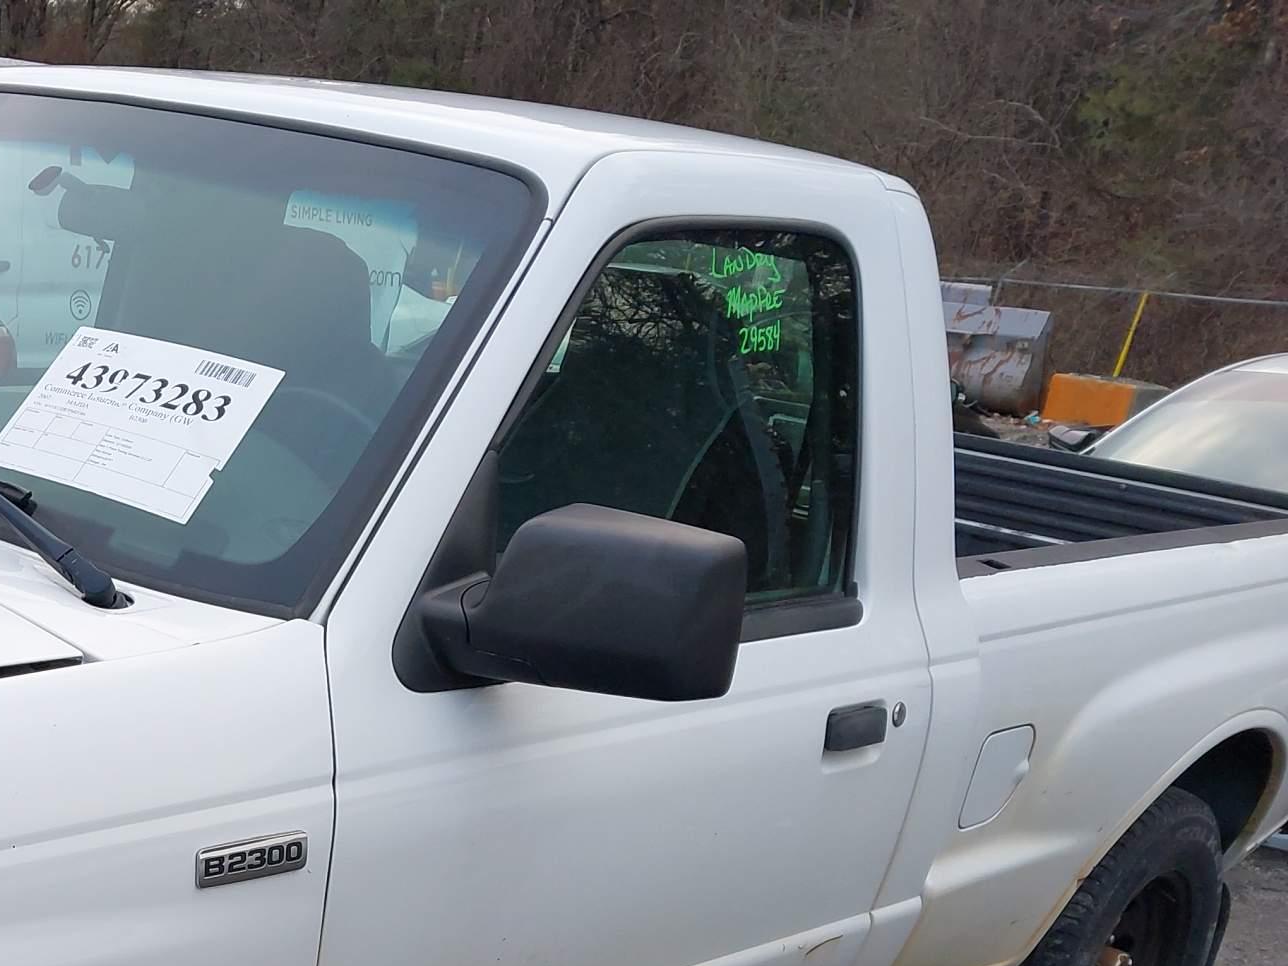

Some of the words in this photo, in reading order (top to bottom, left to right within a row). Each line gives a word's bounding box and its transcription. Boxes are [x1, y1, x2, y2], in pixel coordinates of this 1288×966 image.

[290, 204, 333, 222] SIMPLE
[335, 210, 373, 227] LIVING
[739, 319, 781, 354] 29584
[44, 383, 88, 399] Commerce
[88, 392, 128, 408] Insuranc
[128, 403, 169, 421] Company
[65, 361, 232, 422] 43973283
[203, 841, 303, 878] B2300
